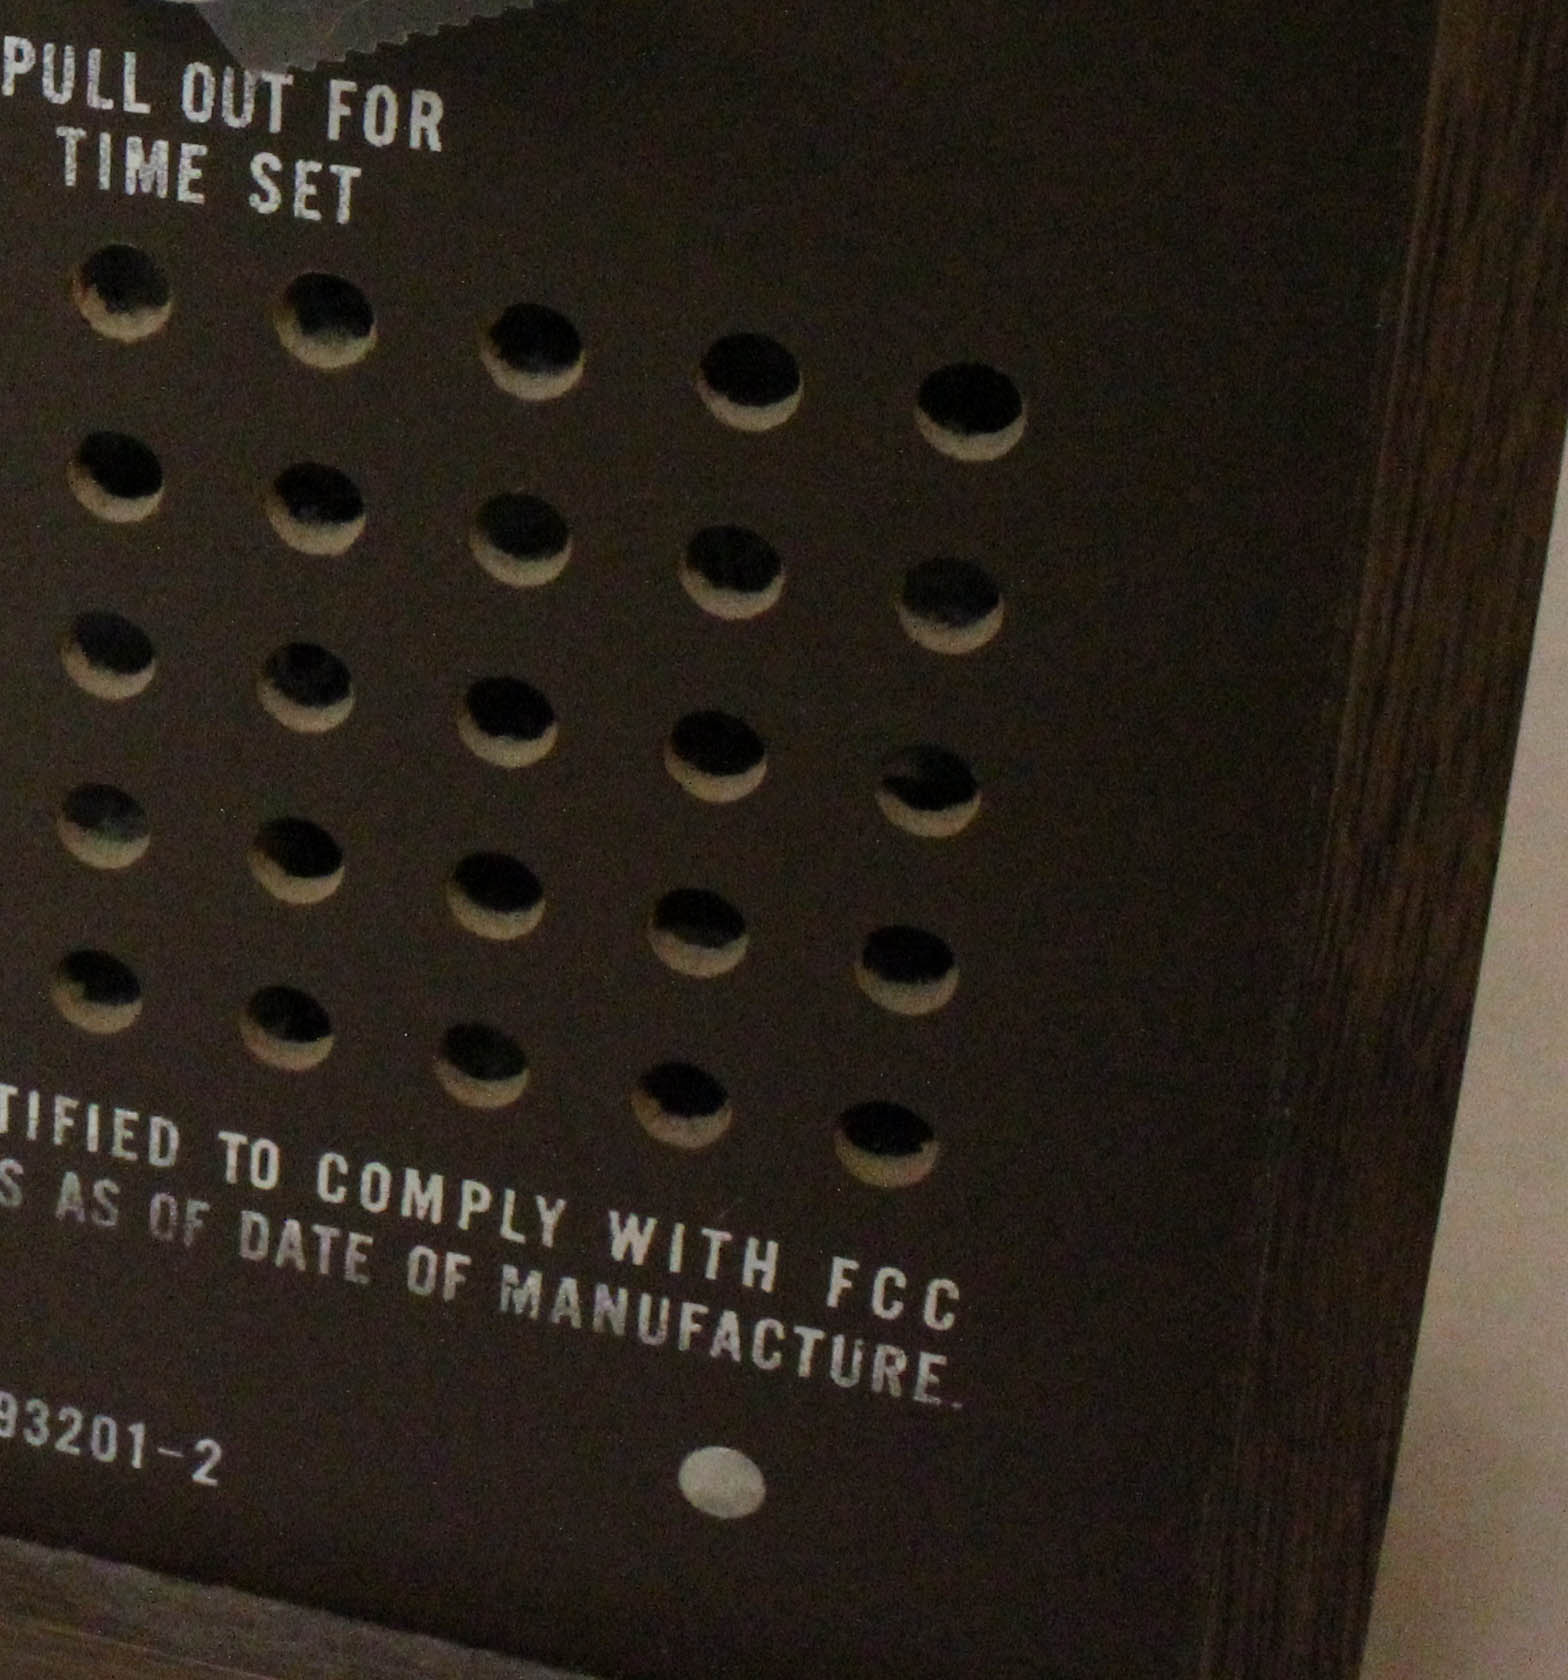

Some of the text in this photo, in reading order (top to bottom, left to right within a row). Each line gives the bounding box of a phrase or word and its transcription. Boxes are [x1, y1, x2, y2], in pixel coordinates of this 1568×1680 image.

[2, 35, 444, 152] PULL OUT FOR
[56, 126, 361, 224] TIME SET
[56, 1171, 120, 1228] AS
[150, 1192, 210, 1248] OF
[240, 1210, 374, 1286] DATE
[407, 1243, 470, 1303] OF
[500, 1263, 963, 1410] MANUFACTURE.
[218, 1130, 280, 1191] TO
[316, 1151, 566, 1248] COMPLY
[609, 1209, 779, 1293] WITH
[827, 1256, 961, 1331] FCC
